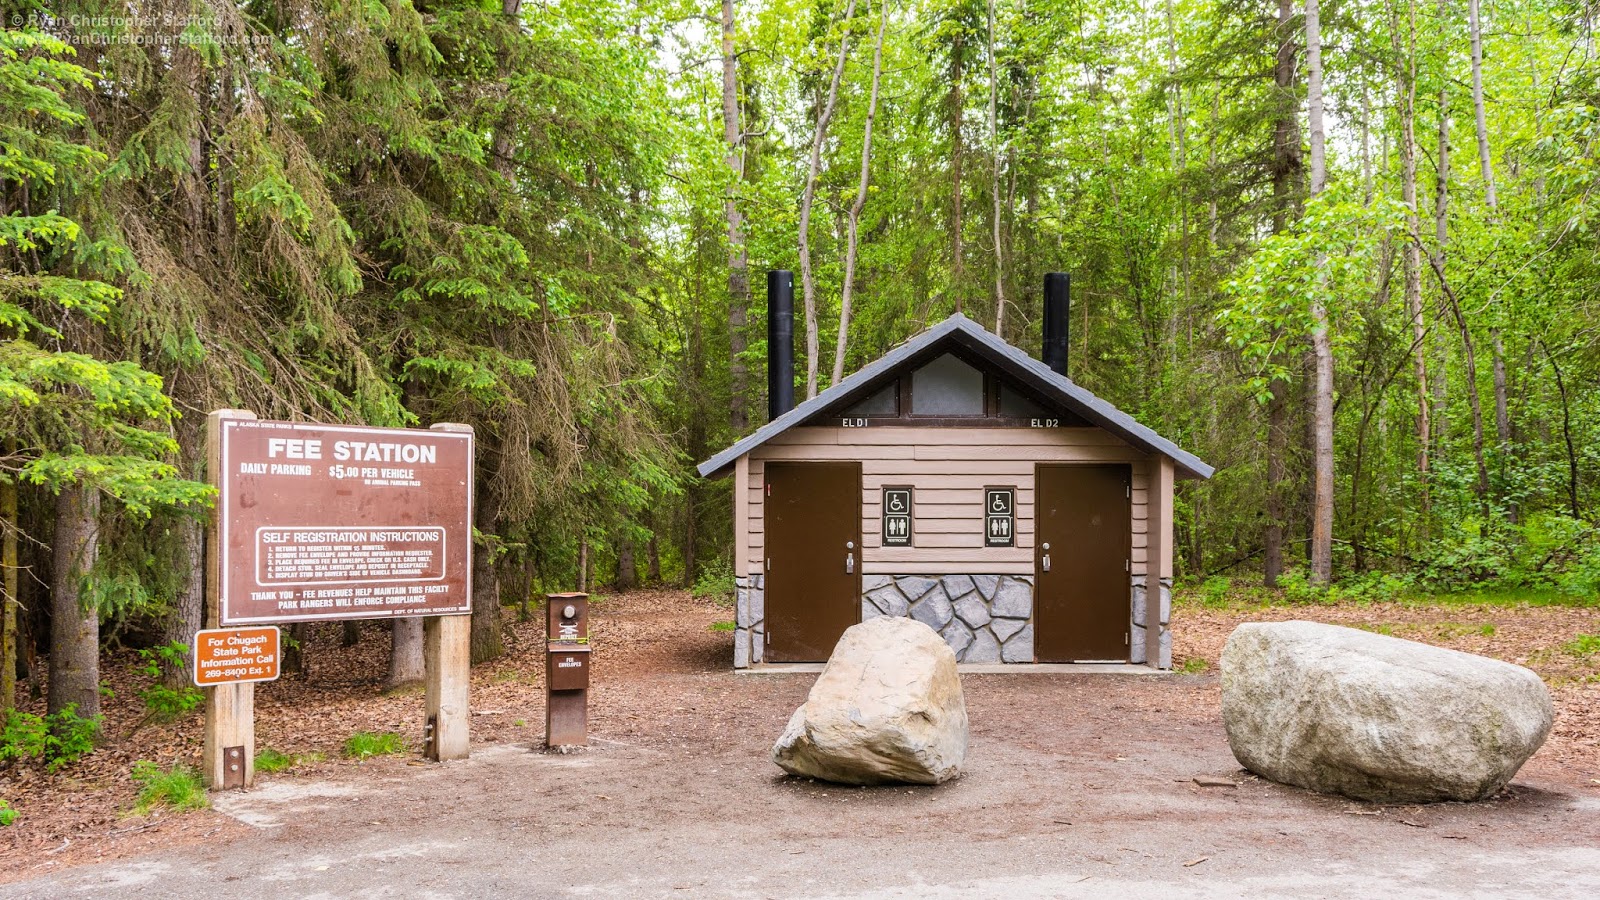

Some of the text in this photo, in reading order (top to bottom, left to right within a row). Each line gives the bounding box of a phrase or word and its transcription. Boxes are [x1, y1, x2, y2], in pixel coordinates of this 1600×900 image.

[268, 438, 436, 463] FEE STATION
[241, 462, 414, 479] DAILY PARKING $5.00 PER VEHICLE
[263, 531, 439, 543] SELF REGISTRATION INSTRUCTIONS
[251, 591, 277, 600] THANK
[279, 590, 294, 599] YOU
[303, 590, 315, 598] FEE
[318, 588, 353, 598] REVENUES
[355, 588, 372, 596] HELP
[374, 586, 406, 595] MAINTAIN
[278, 595, 426, 609] PARK RANGERS WILL ENFORCE COMPLIANCE
[208, 635, 267, 646] For Chugach
[213, 646, 262, 657] State Park
[201, 655, 273, 668] Information Call
[205, 668, 247, 678] 269-8400
[249, 666, 263, 675] Ext.
